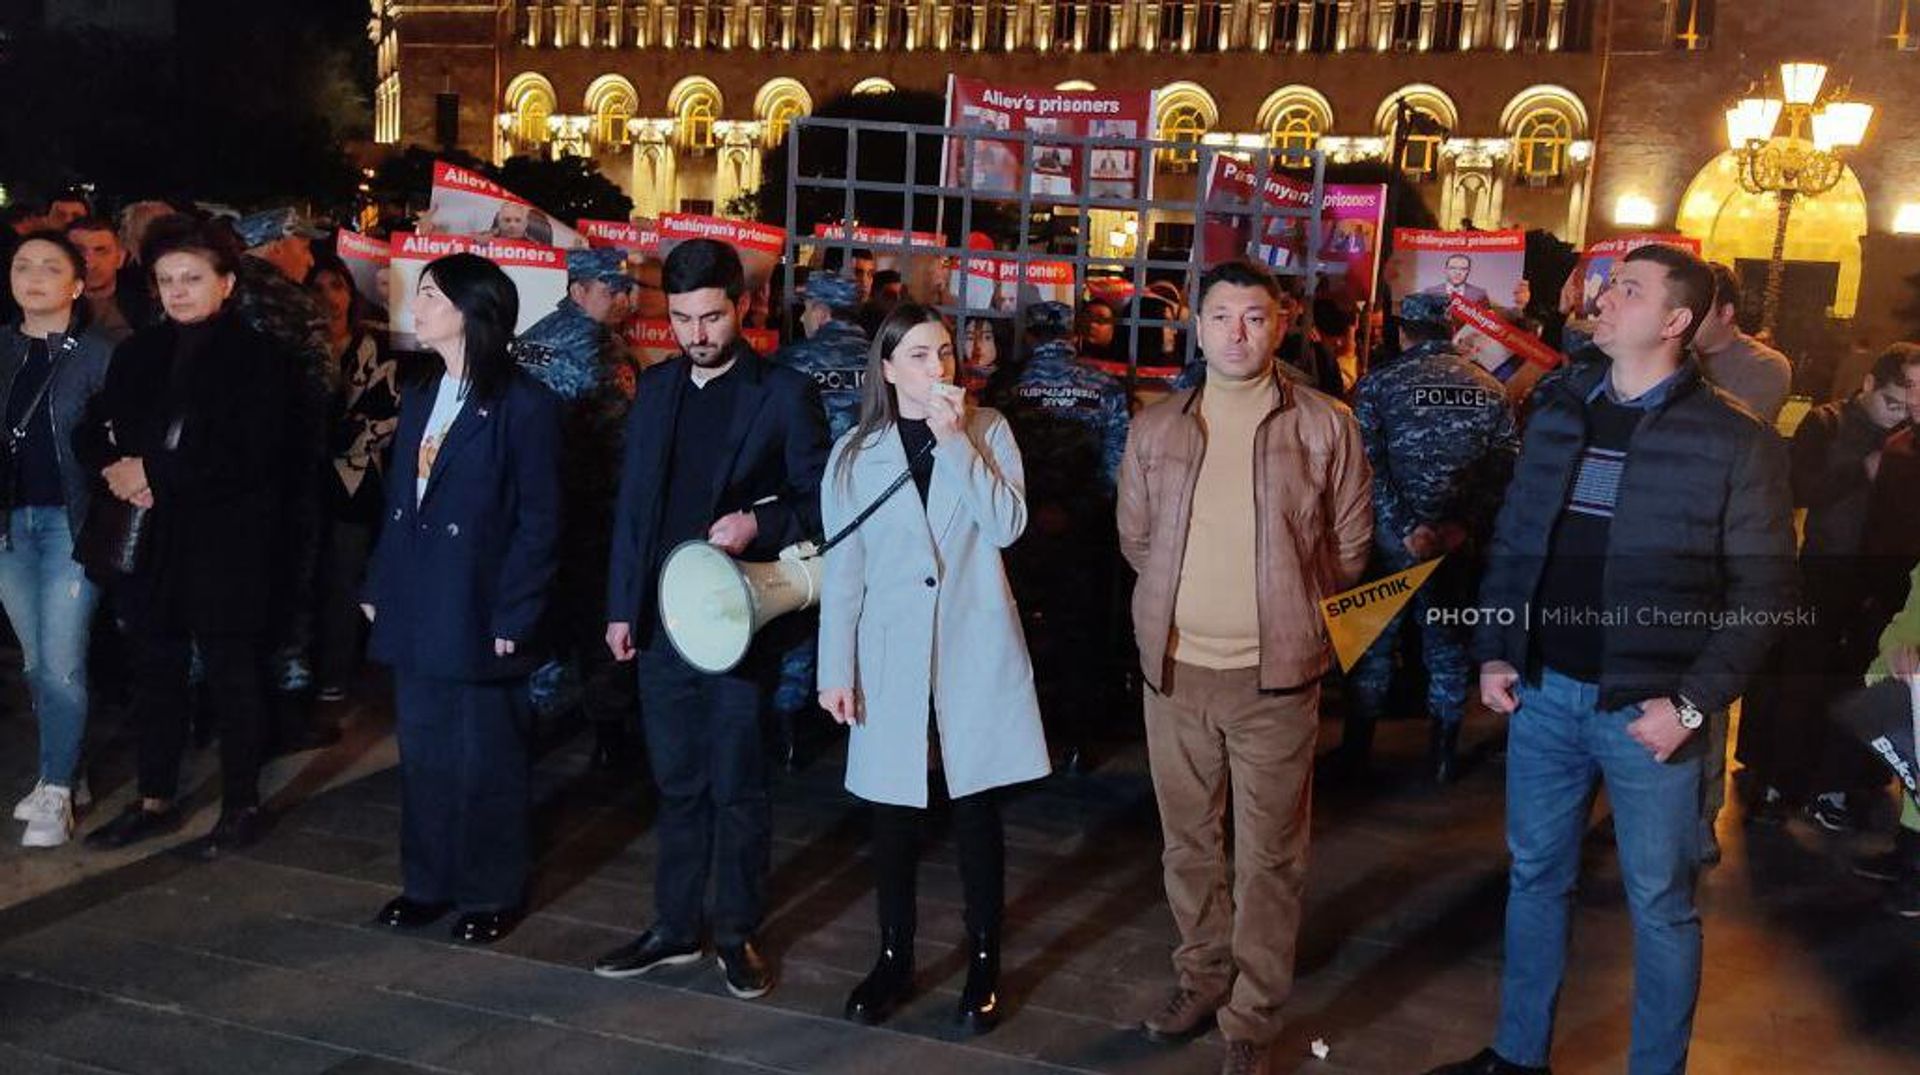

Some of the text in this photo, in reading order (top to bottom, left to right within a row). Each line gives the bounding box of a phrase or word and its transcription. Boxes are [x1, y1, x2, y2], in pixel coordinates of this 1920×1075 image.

[982, 89, 1120, 115] Aliev's prisoners
[402, 237, 464, 254] Aliev's
[1415, 388, 1485, 406] POLICE
